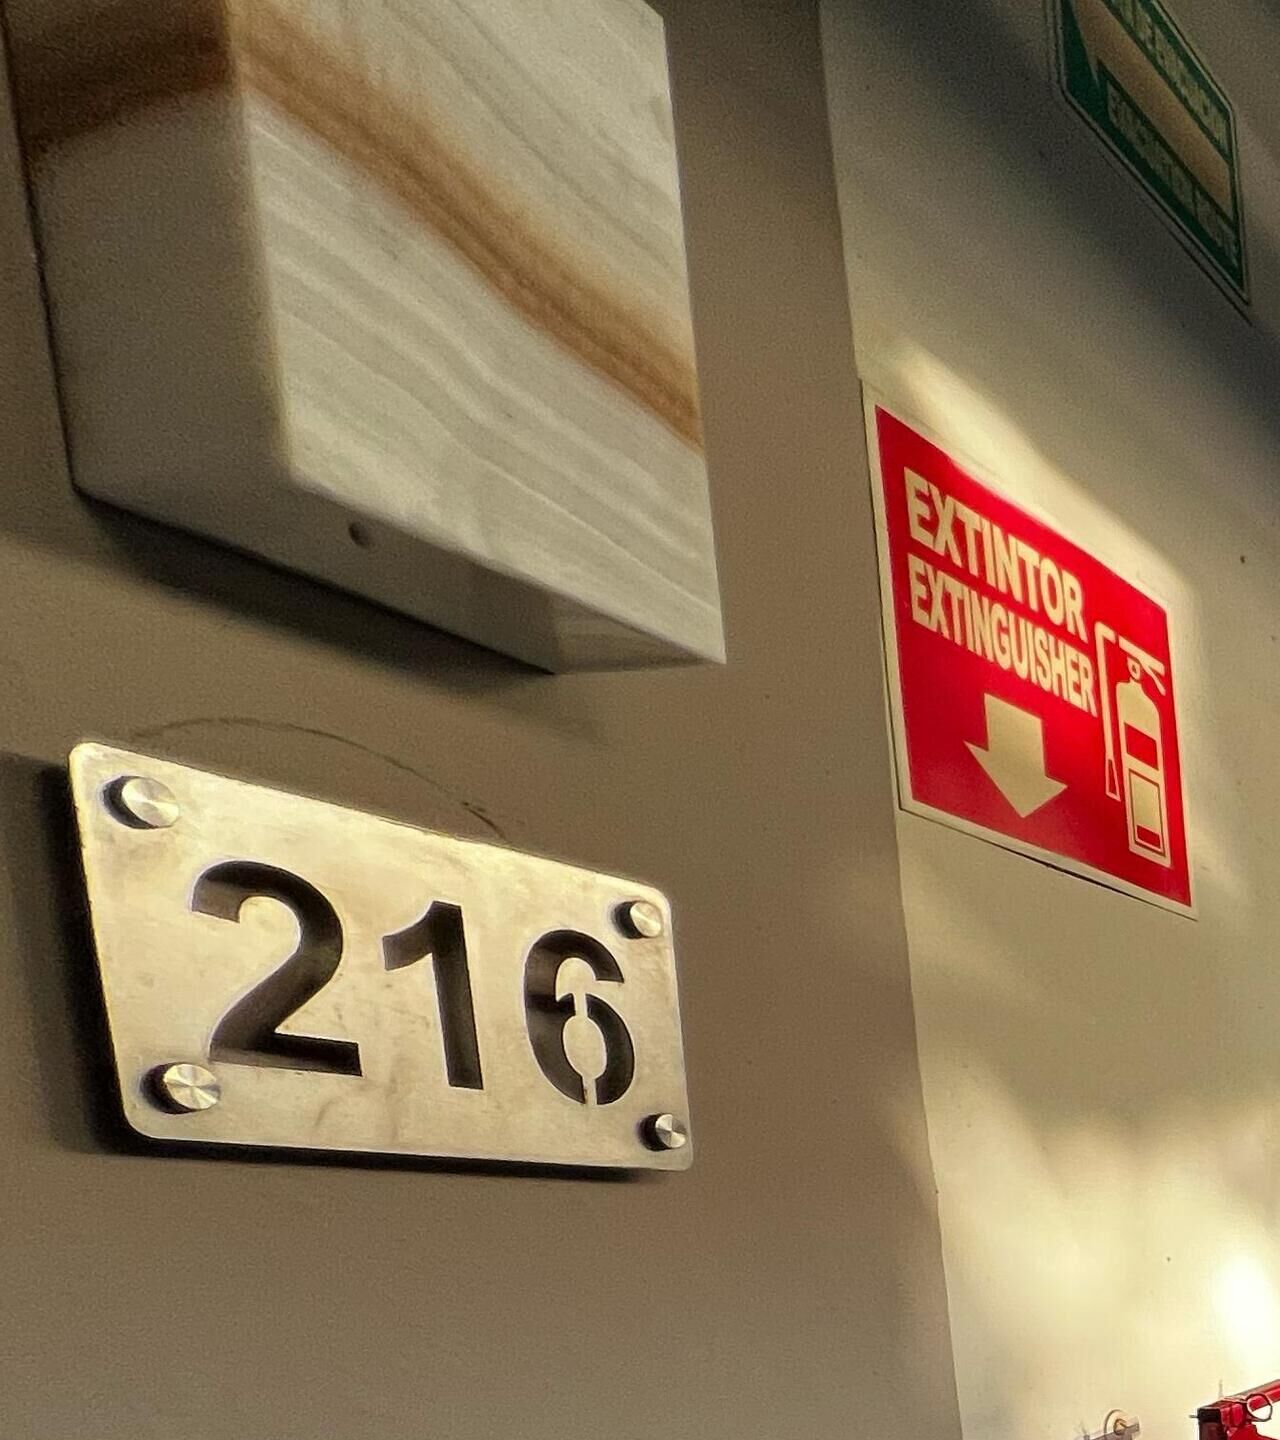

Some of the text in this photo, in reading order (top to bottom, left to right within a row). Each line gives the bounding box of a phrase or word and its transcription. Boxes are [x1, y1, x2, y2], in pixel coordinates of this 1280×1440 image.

[904, 466, 1089, 643] EXTINTOR
[908, 552, 1098, 717] EXTINGUISHER
[191, 860, 635, 1106] 216
